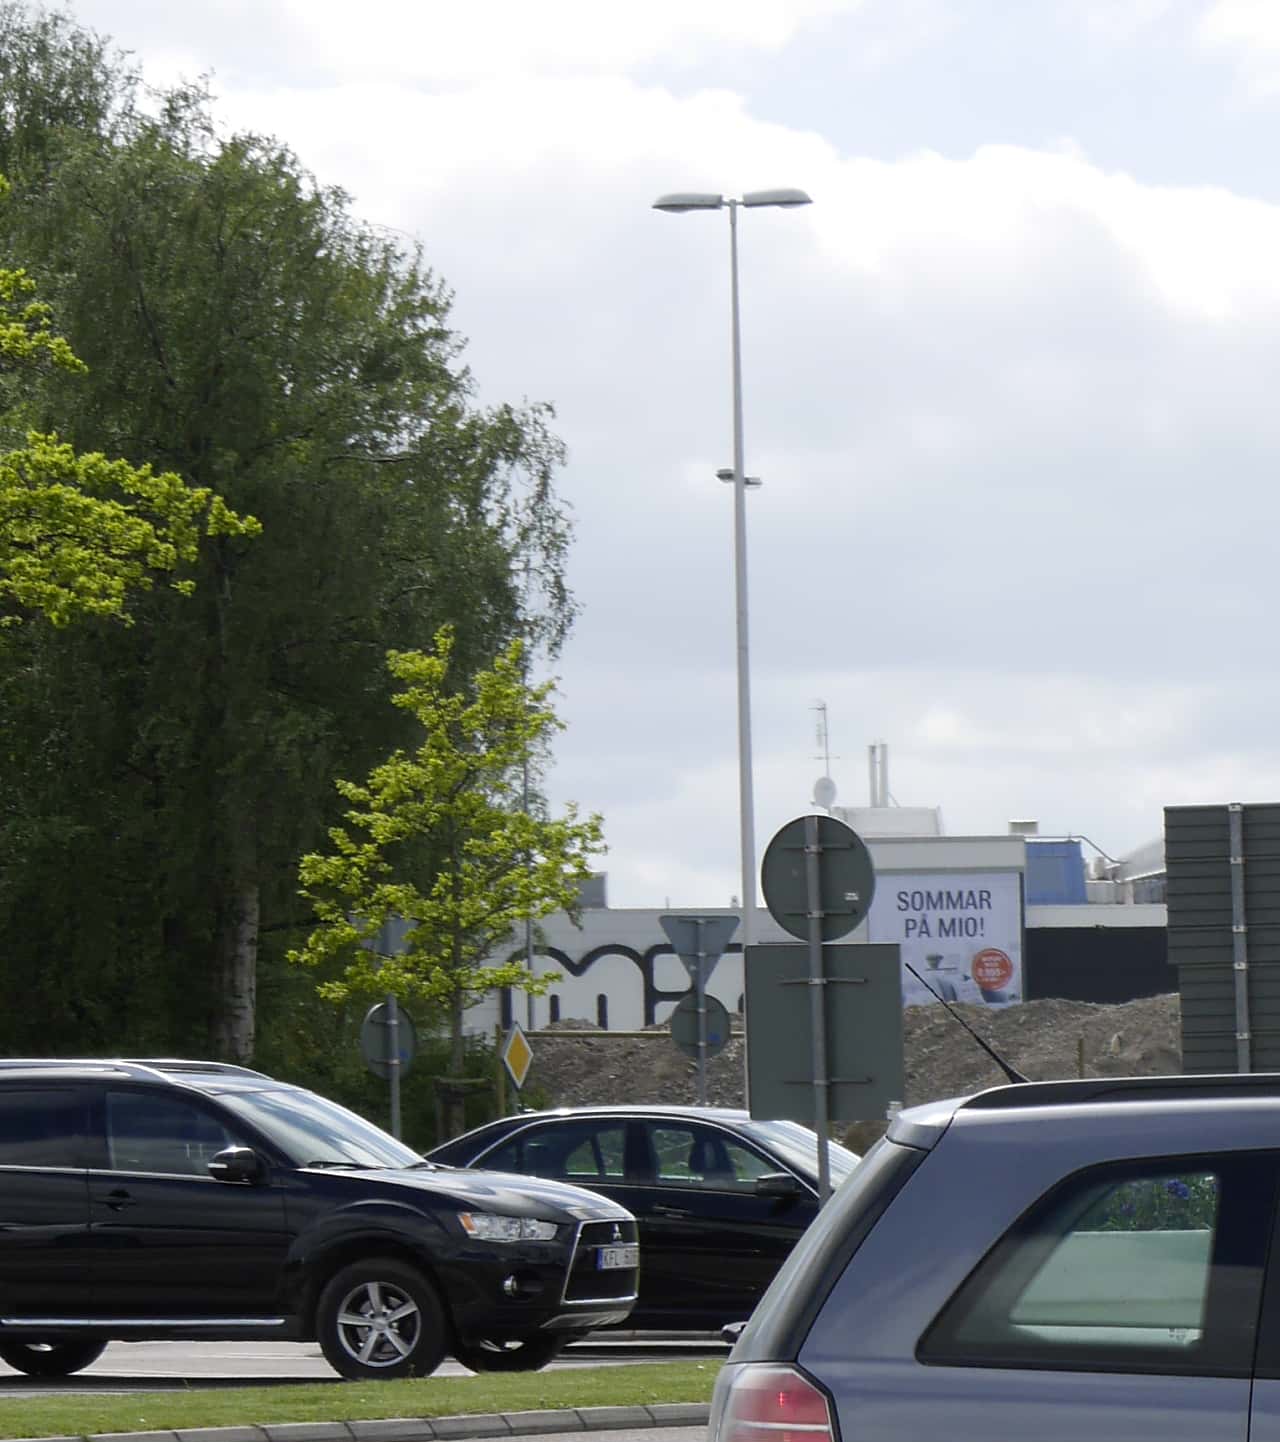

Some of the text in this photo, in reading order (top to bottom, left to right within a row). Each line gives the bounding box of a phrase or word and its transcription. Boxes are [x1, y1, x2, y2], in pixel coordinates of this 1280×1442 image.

[896, 889, 992, 912] SOMMAR
[904, 913, 985, 938] PÅ MIO!
